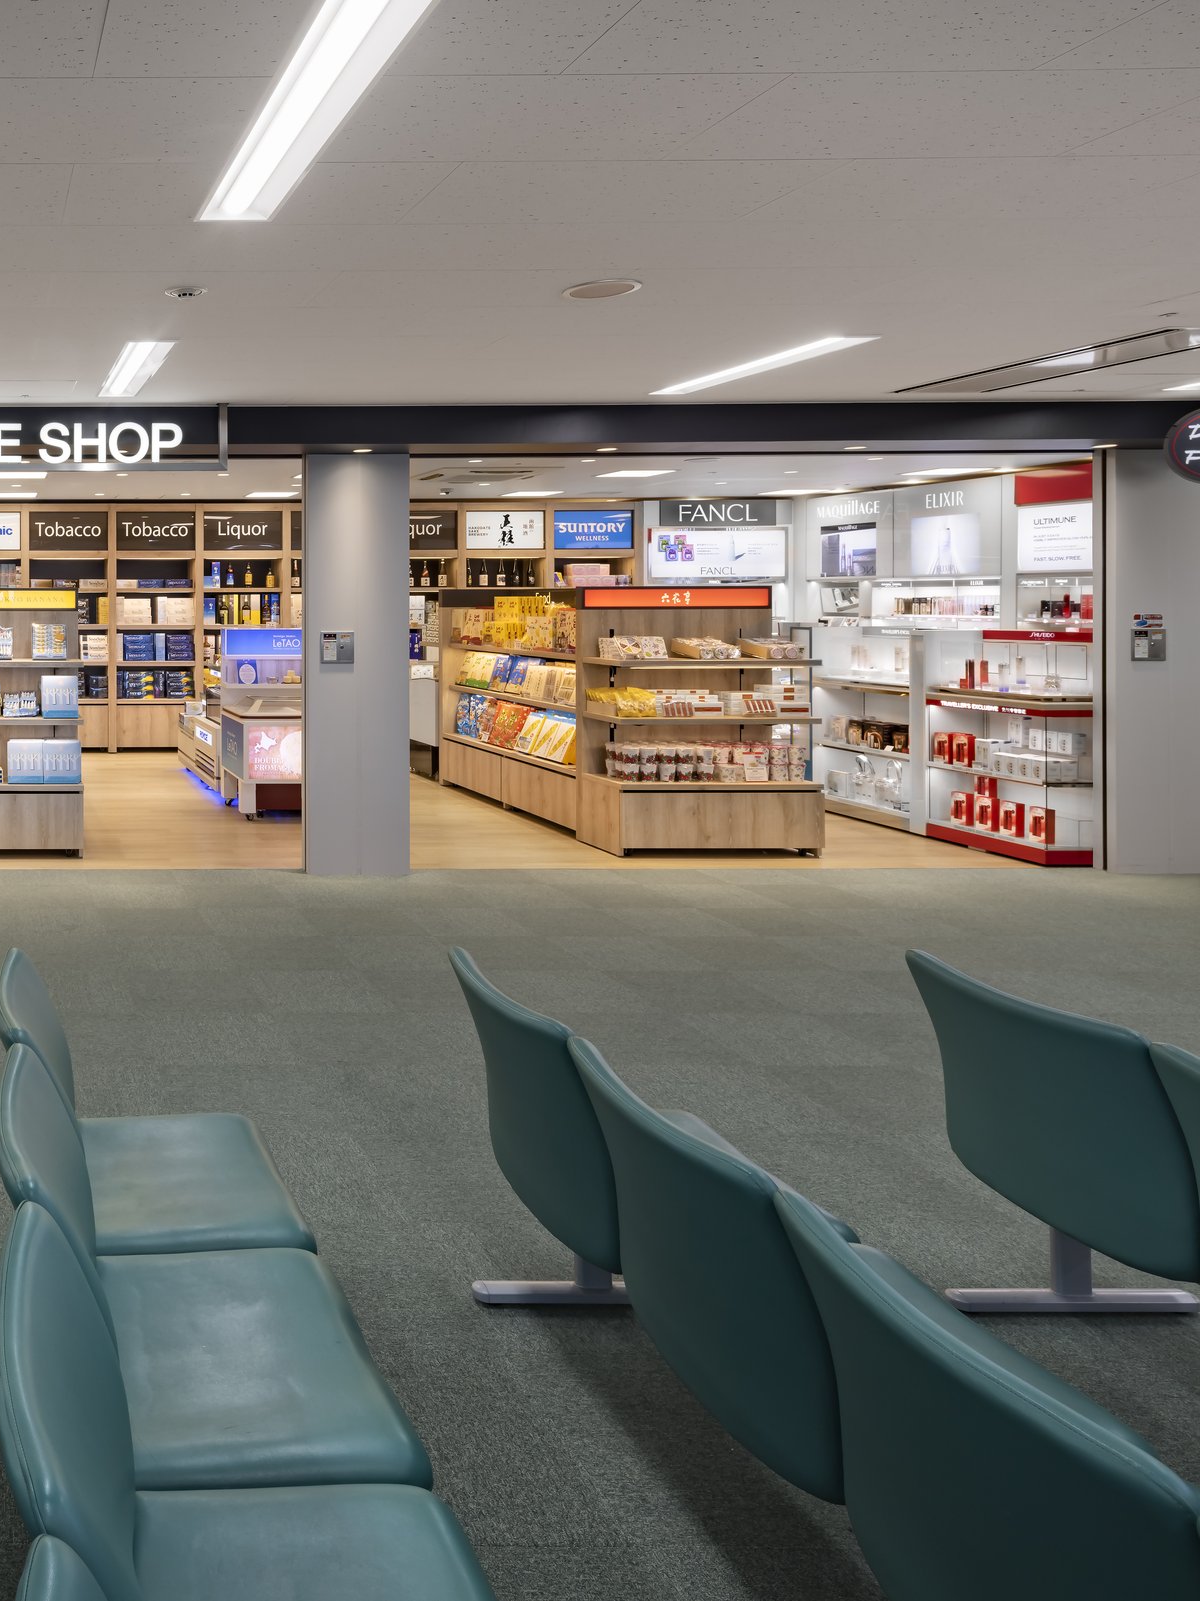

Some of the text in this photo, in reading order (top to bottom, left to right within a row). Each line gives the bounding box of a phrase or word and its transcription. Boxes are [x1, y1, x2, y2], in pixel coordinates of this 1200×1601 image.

[38, 421, 183, 464] SHOP
[925, 490, 964, 509] ELIXIR
[678, 503, 758, 522] FANCL
[559, 522, 626, 533] SUNTORY
[1033, 516, 1077, 526] ULTIMUNE
[34, 522, 102, 537] Tobacco
[121, 522, 189, 537] Tobacco
[217, 521, 268, 540] Liquor
[700, 566, 736, 575] FANCL
[535, 592, 551, 604] Fod
[661, 591, 691, 605] 六花亭
[272, 638, 301, 648] LeTAO
